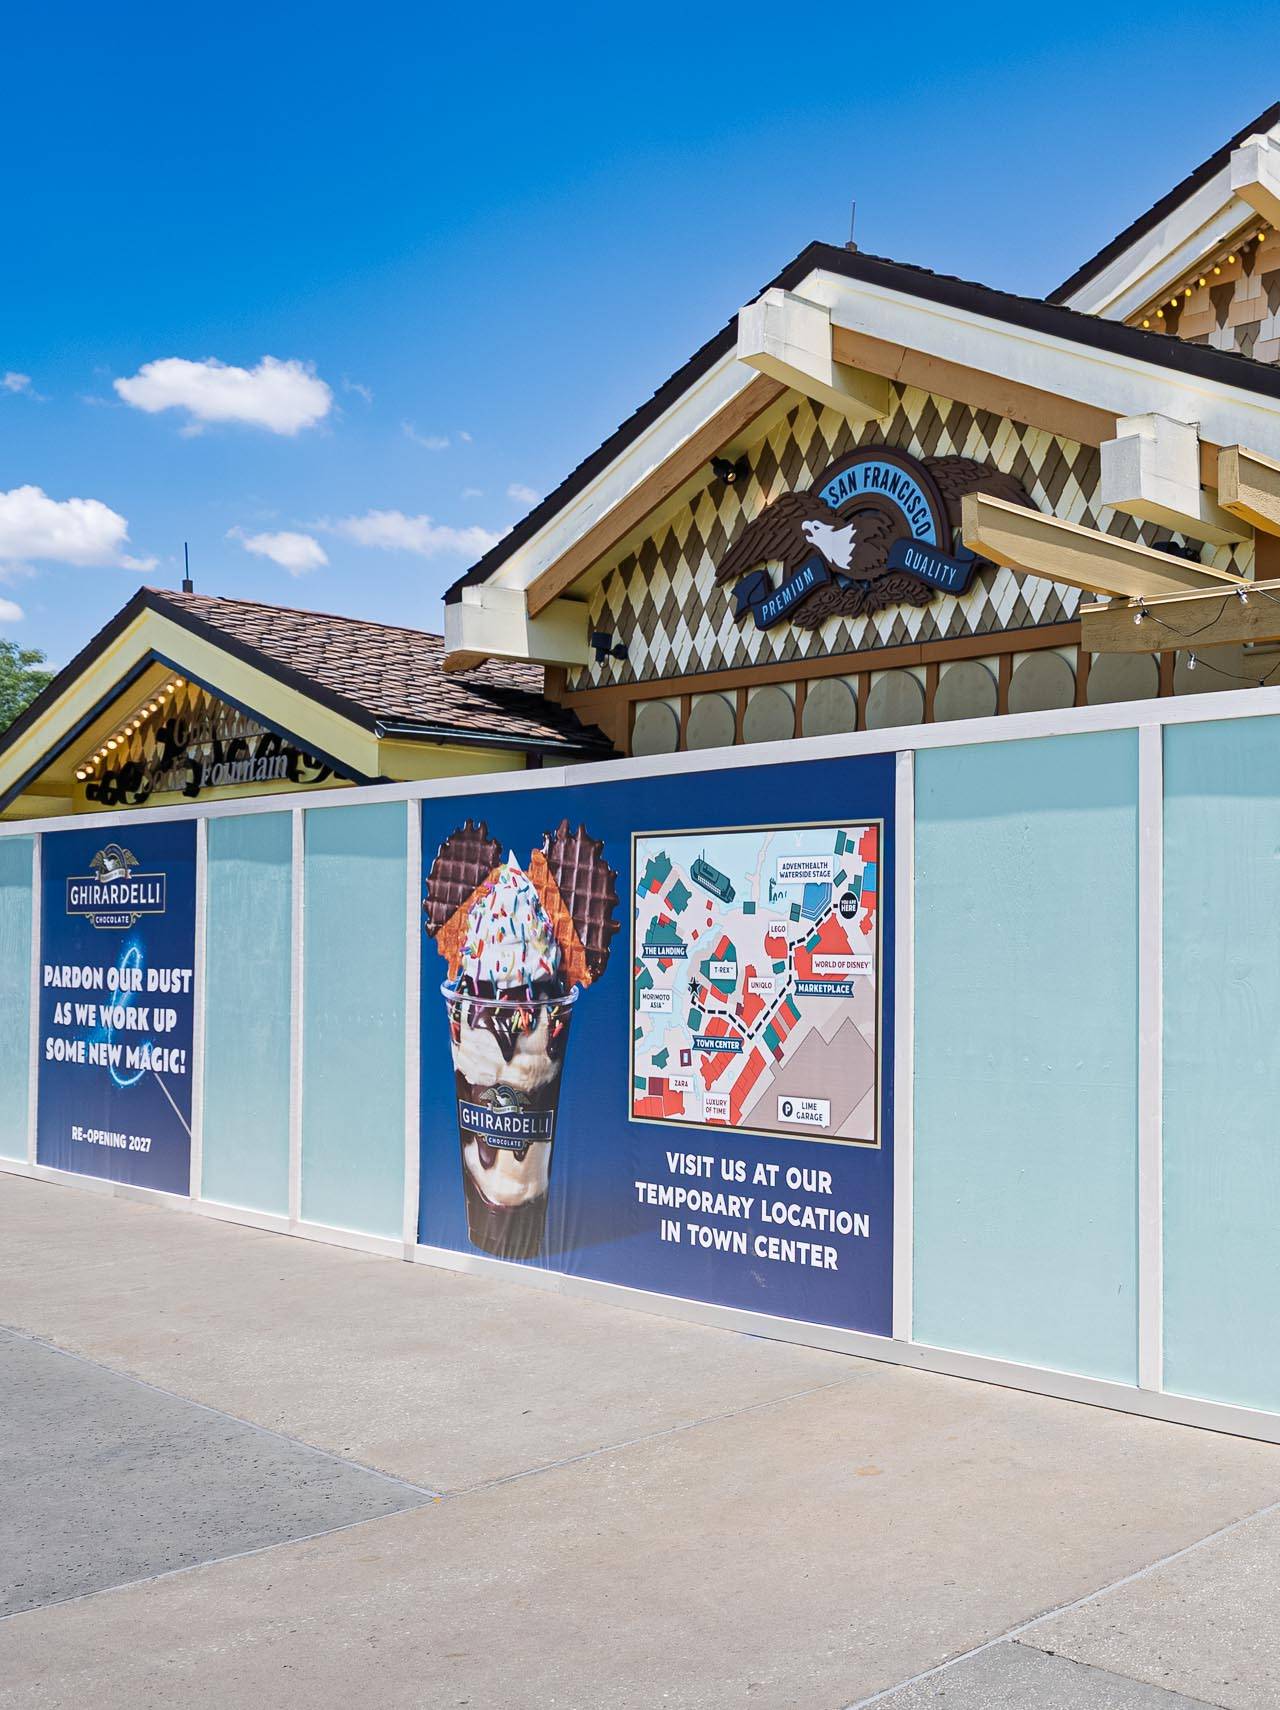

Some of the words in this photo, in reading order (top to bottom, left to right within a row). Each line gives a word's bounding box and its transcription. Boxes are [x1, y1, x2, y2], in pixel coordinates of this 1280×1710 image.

[829, 473, 857, 505] SAN
[863, 466, 932, 537] FRANCISCO
[904, 548, 958, 585] QUALITY
[761, 567, 815, 622] PREMIUM
[198, 753, 289, 788] Fountain
[782, 861, 828, 870] ADVENTHEALTH
[780, 871, 811, 879] WATERSIDE
[812, 870, 831, 878] STAGE
[70, 883, 160, 905] GHIRARDELLI
[841, 904, 857, 912] HERE
[95, 915, 129, 924] CHOCOLATE
[771, 925, 785, 933] LEGO
[645, 947, 657, 955] THE
[658, 947, 685, 956] LANDING
[815, 960, 836, 968] WORLD
[43, 965, 103, 989] PARDON
[106, 966, 143, 992] OUR
[147, 968, 193, 993] DUST
[750, 981, 772, 990] UNIQLO
[798, 984, 850, 994] MARKETPLACE
[642, 993, 670, 1001] MORIMOTO
[53, 1002, 72, 1026] AS
[75, 1003, 97, 1027] WE
[99, 1005, 150, 1031] WORK
[153, 1008, 177, 1032] UP
[696, 1038, 714, 1048] TOWN
[715, 1040, 740, 1050] CENTER
[45, 1037, 86, 1064] SOME
[88, 1042, 122, 1067] NEW
[126, 1045, 186, 1074] MAGIC!
[674, 1079, 689, 1087] ZARA
[706, 1098, 727, 1107] LUXURY
[801, 1101, 817, 1111] LIME
[706, 1106, 713, 1114] OF
[713, 1107, 726, 1115] TIME
[462, 1107, 549, 1134] GHIRARDELLI
[796, 1111, 823, 1122] GARAGE
[71, 1125, 127, 1149] RE-OPENING
[128, 1135, 152, 1153] 2027
[488, 1136, 521, 1147] CHOCOLATE
[666, 1151, 715, 1178] VISIT
[720, 1158, 747, 1182] US
[752, 1163, 780, 1187] AT
[785, 1166, 833, 1195] OUR
[634, 1181, 755, 1219] TEMPORARY
[761, 1199, 870, 1238] LOCATION
[660, 1219, 681, 1243] IN
[687, 1223, 747, 1255] TOWN
[754, 1235, 838, 1271] CENTER
